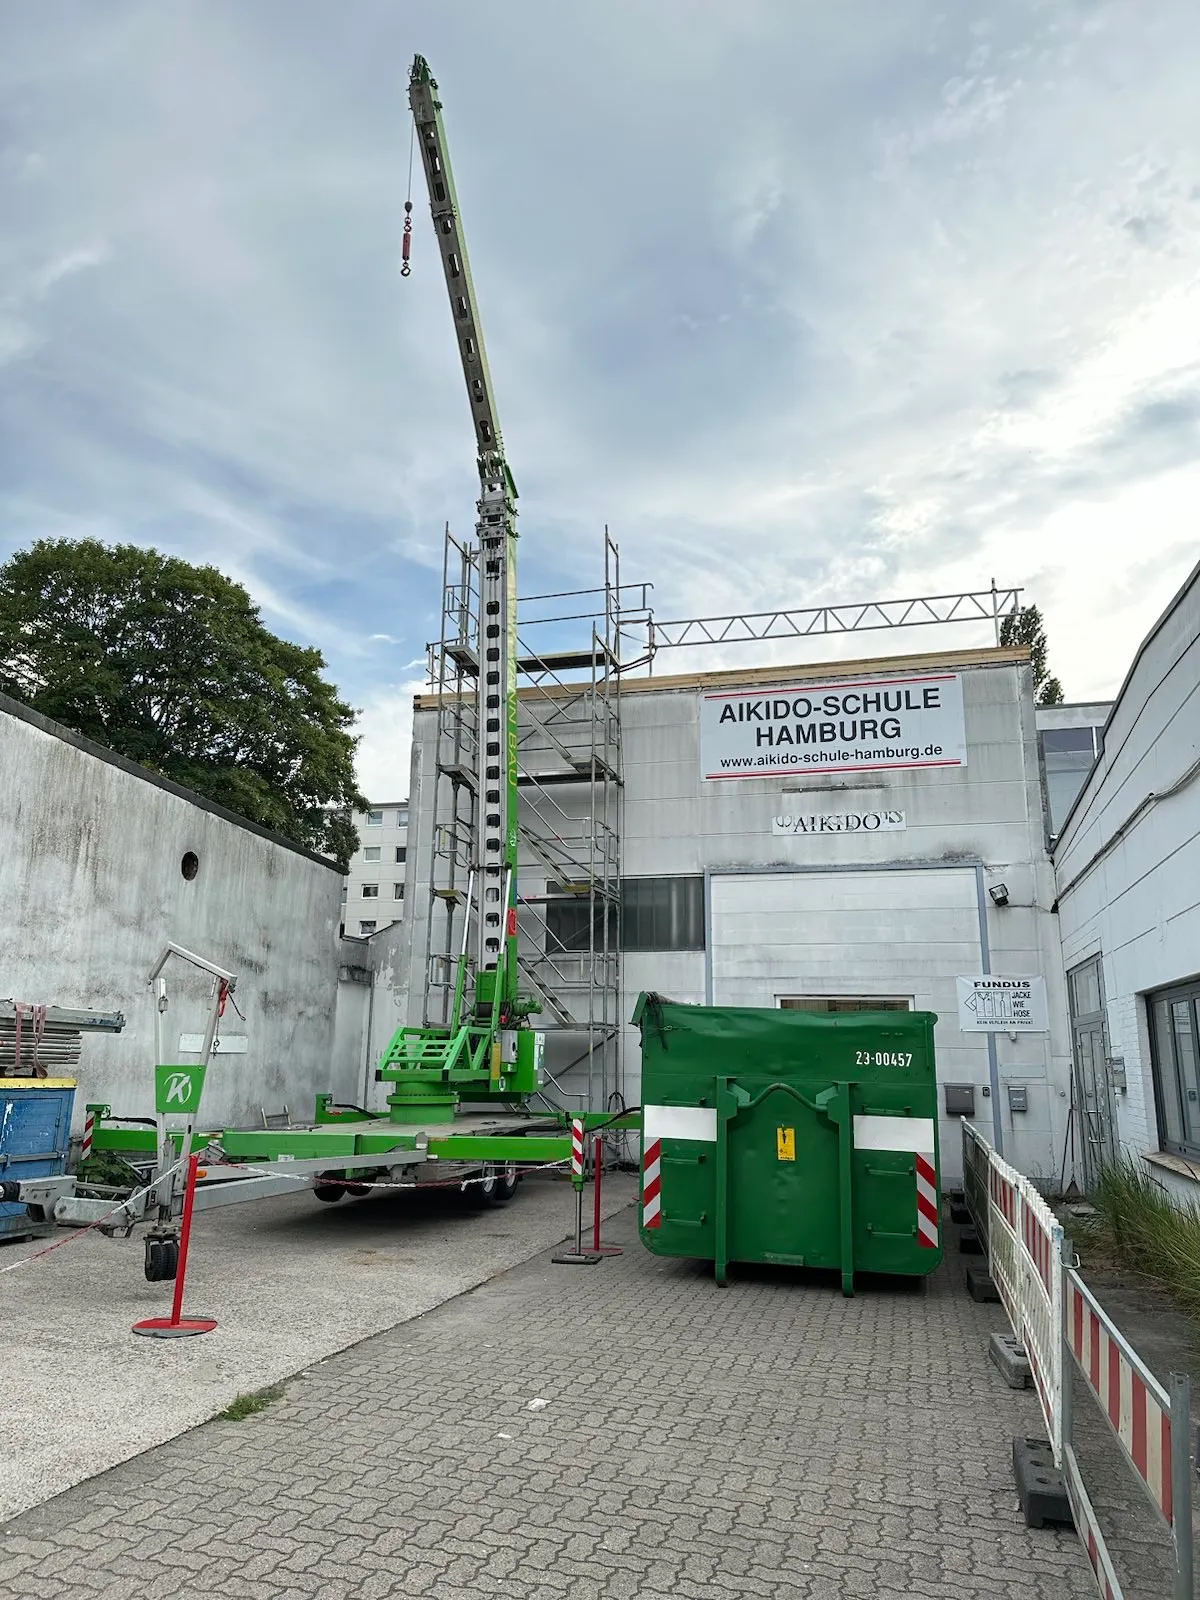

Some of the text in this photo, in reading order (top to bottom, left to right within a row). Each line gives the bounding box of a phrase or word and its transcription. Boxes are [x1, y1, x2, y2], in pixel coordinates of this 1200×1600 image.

[719, 687, 942, 724] AIKIDO-SCHULE
[755, 717, 902, 747] HAMBURG
[508, 732, 517, 786] BAU
[720, 743, 943, 768] www.aikido-schule-hamburg.de
[793, 813, 881, 832] AIKIDO
[1011, 991, 1031, 999] JACKE
[1013, 1010, 1031, 1018] HOSE
[855, 1051, 913, 1067] 23-00457
